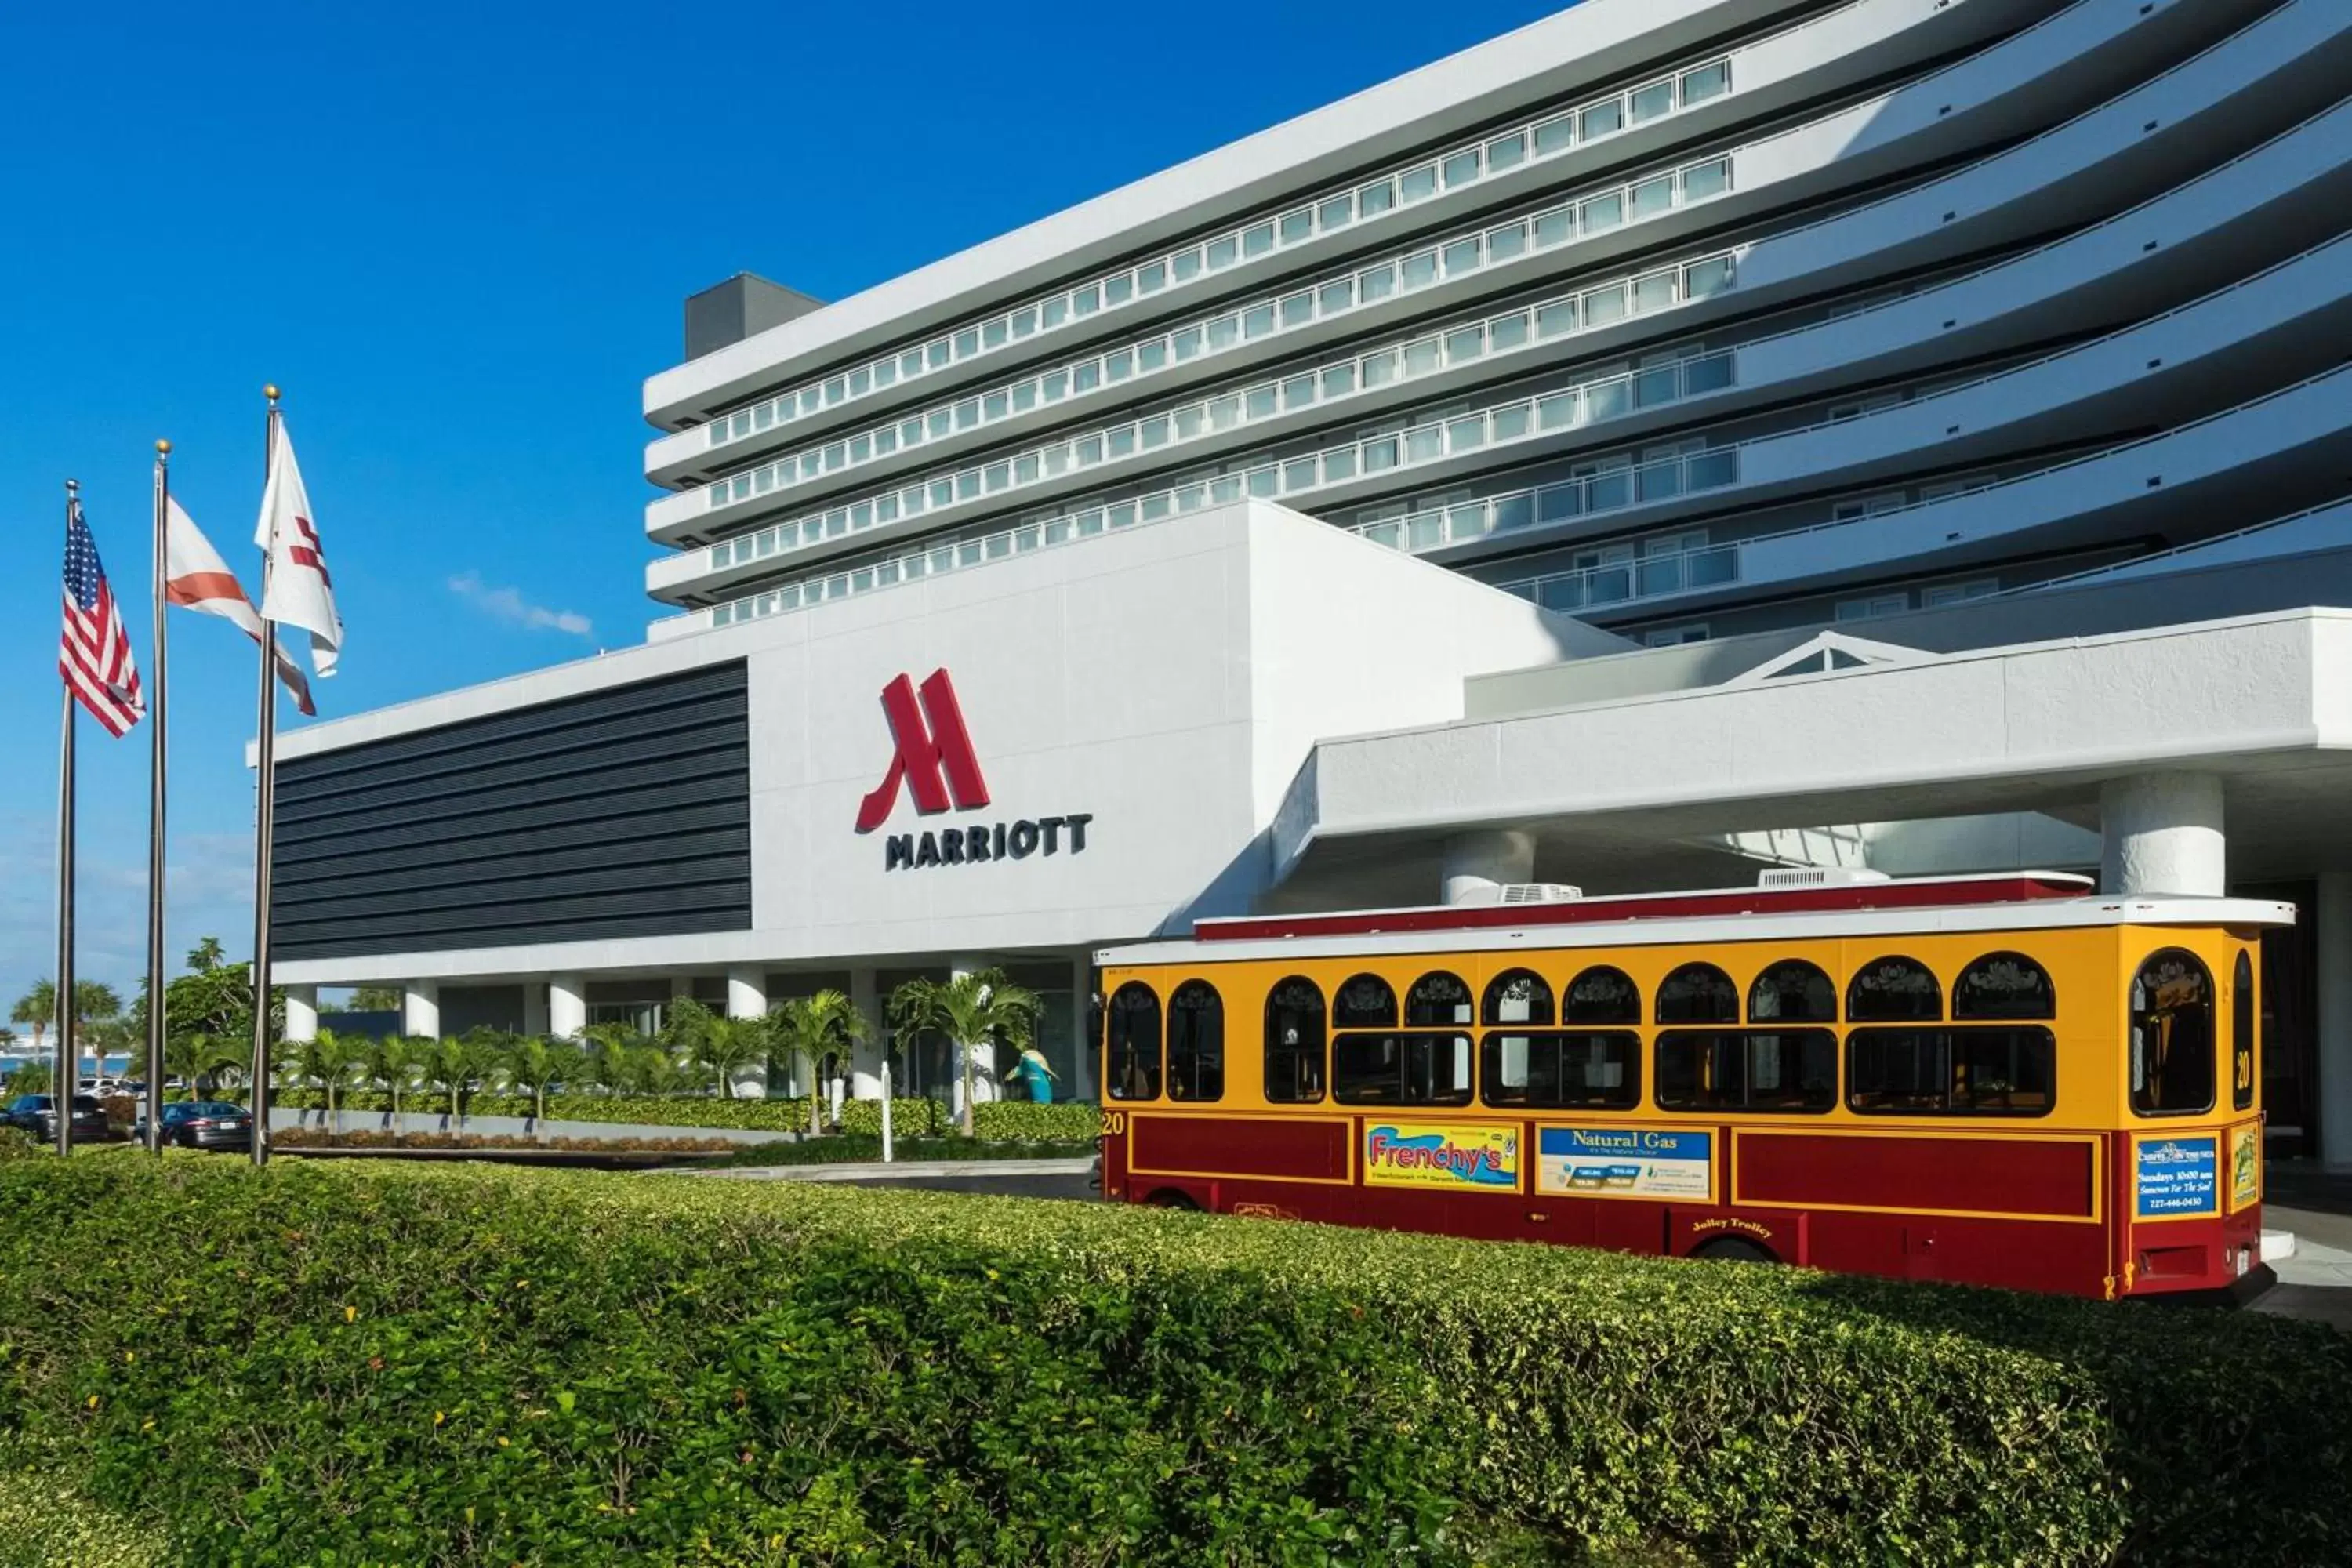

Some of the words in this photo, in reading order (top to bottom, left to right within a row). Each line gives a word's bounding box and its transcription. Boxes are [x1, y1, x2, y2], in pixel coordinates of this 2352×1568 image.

[885, 814, 1094, 872] MARRIOTT
[2237, 1051, 2249, 1090] 20
[1102, 1112, 1124, 1134] 20
[1572, 1130, 1639, 1148] Natural
[1644, 1132, 1678, 1149] Gas
[1370, 1136, 1503, 1176] Frenchy's
[2138, 1171, 2174, 1184] Sundays
[1693, 1218, 1728, 1232] Jolley
[1730, 1218, 1773, 1239] Trolley
